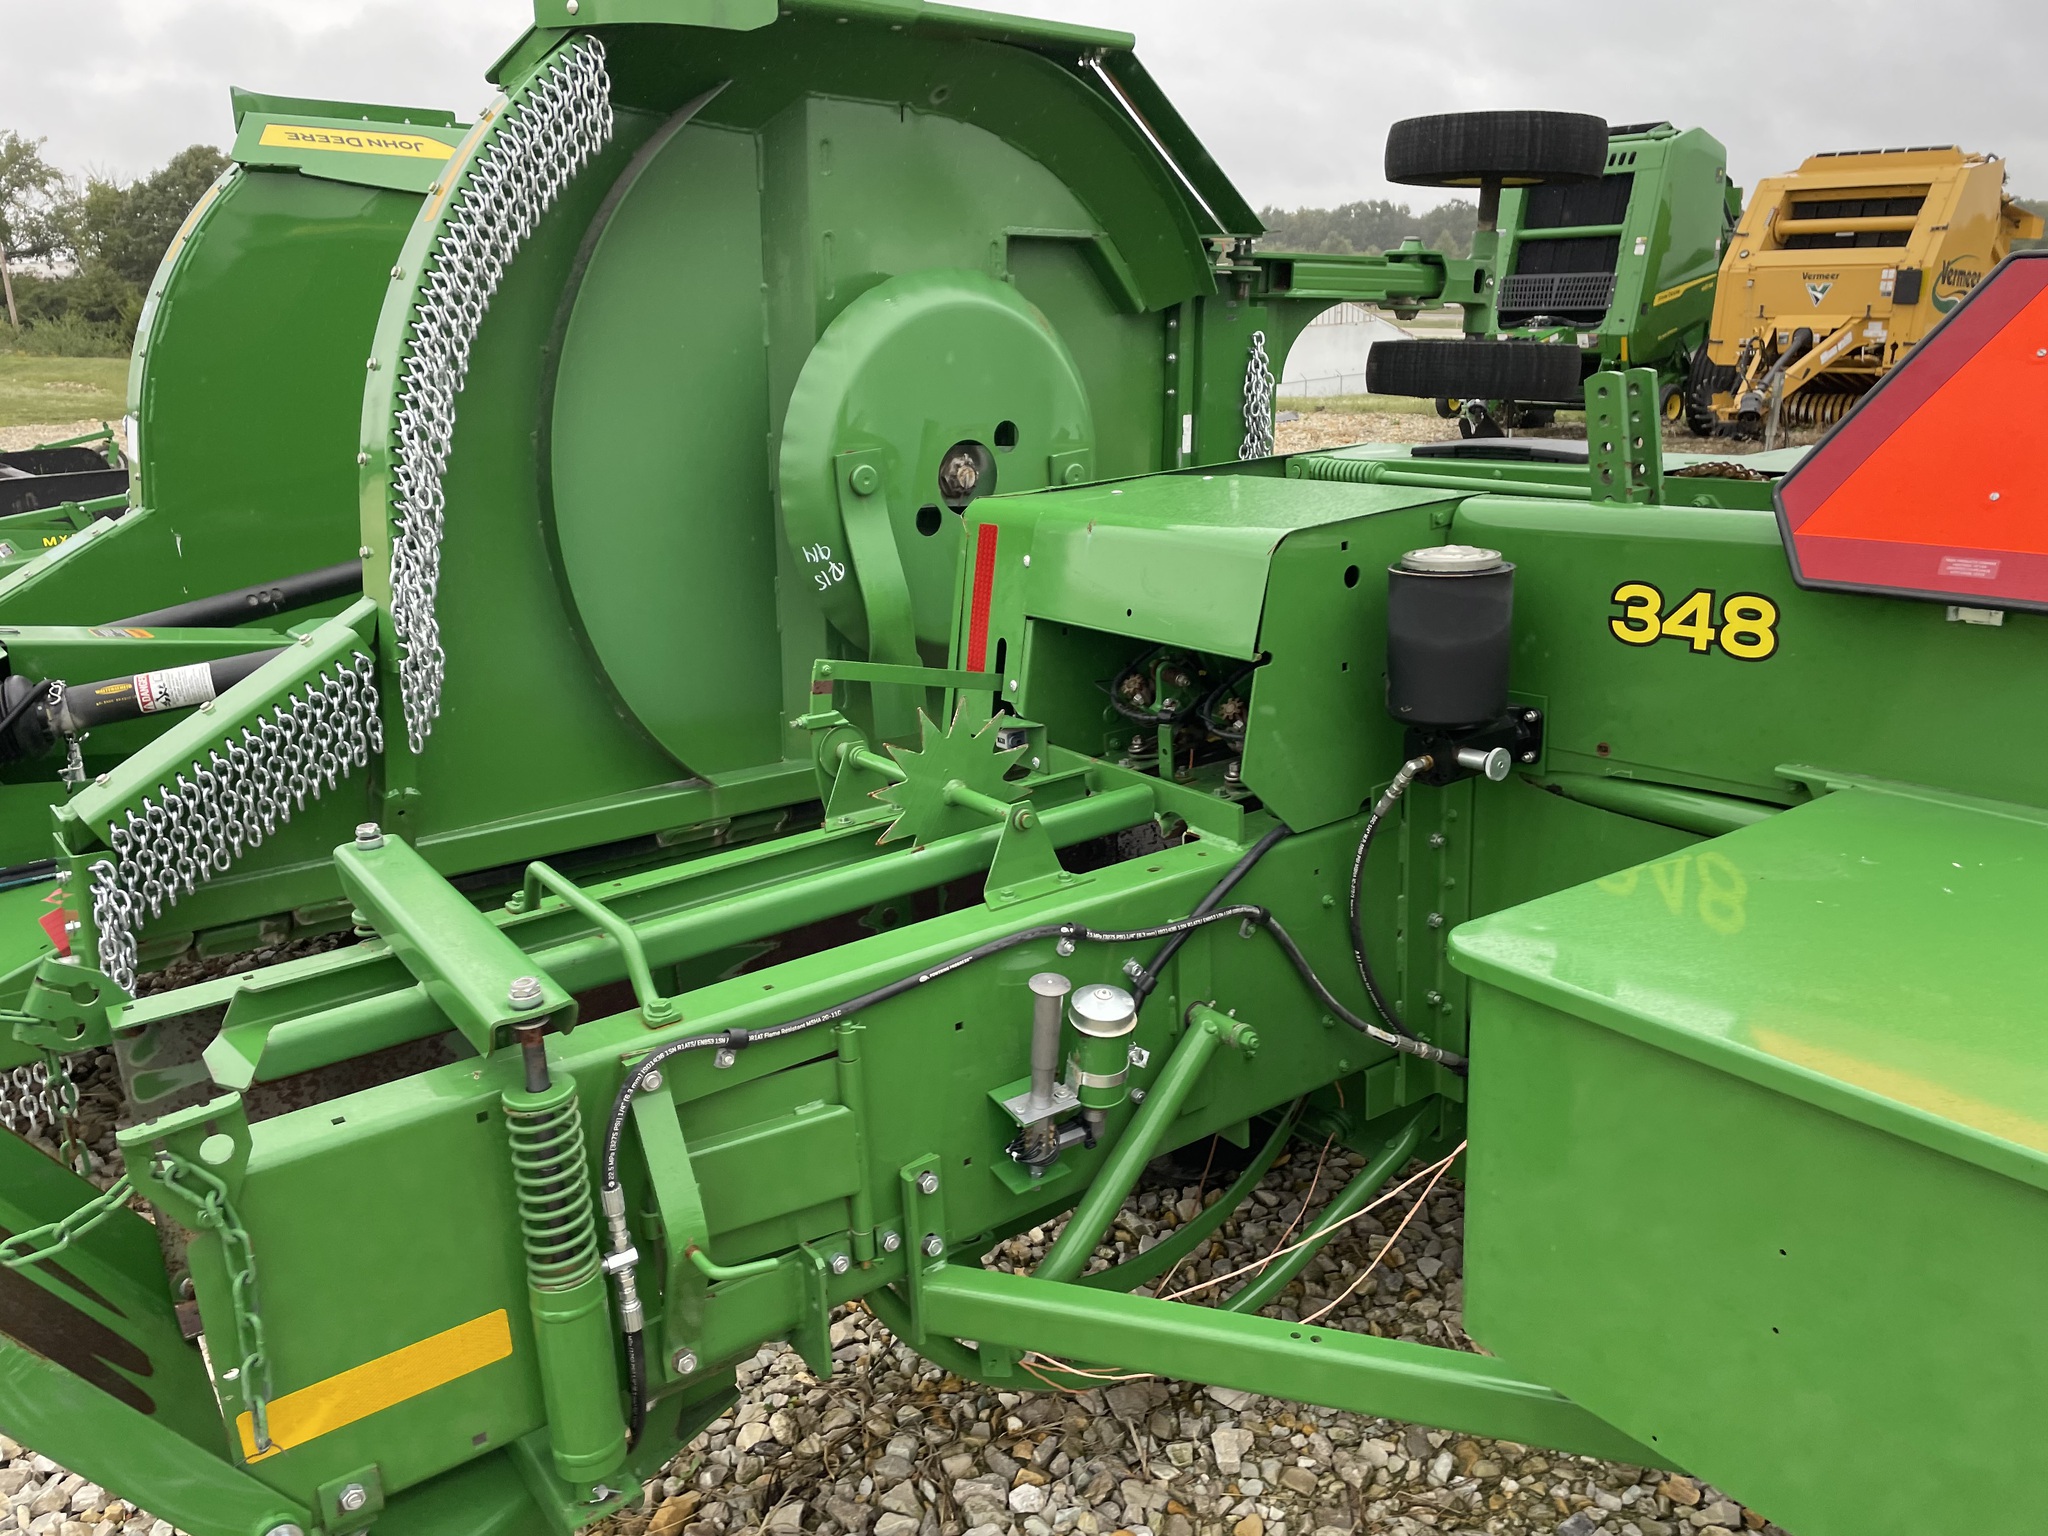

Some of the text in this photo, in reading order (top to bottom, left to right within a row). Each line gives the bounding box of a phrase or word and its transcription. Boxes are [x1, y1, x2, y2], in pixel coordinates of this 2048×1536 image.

[284, 131, 424, 152] JOHN DEERE
[1802, 272, 1840, 280] Vermeer
[1940, 259, 1982, 288] Vermeer
[42, 533, 77, 547] MX
[1608, 580, 1780, 662] 348
[764, 1030, 781, 1039] Flame
[780, 1023, 806, 1035] Resistant
[806, 1017, 822, 1027] MSHA
